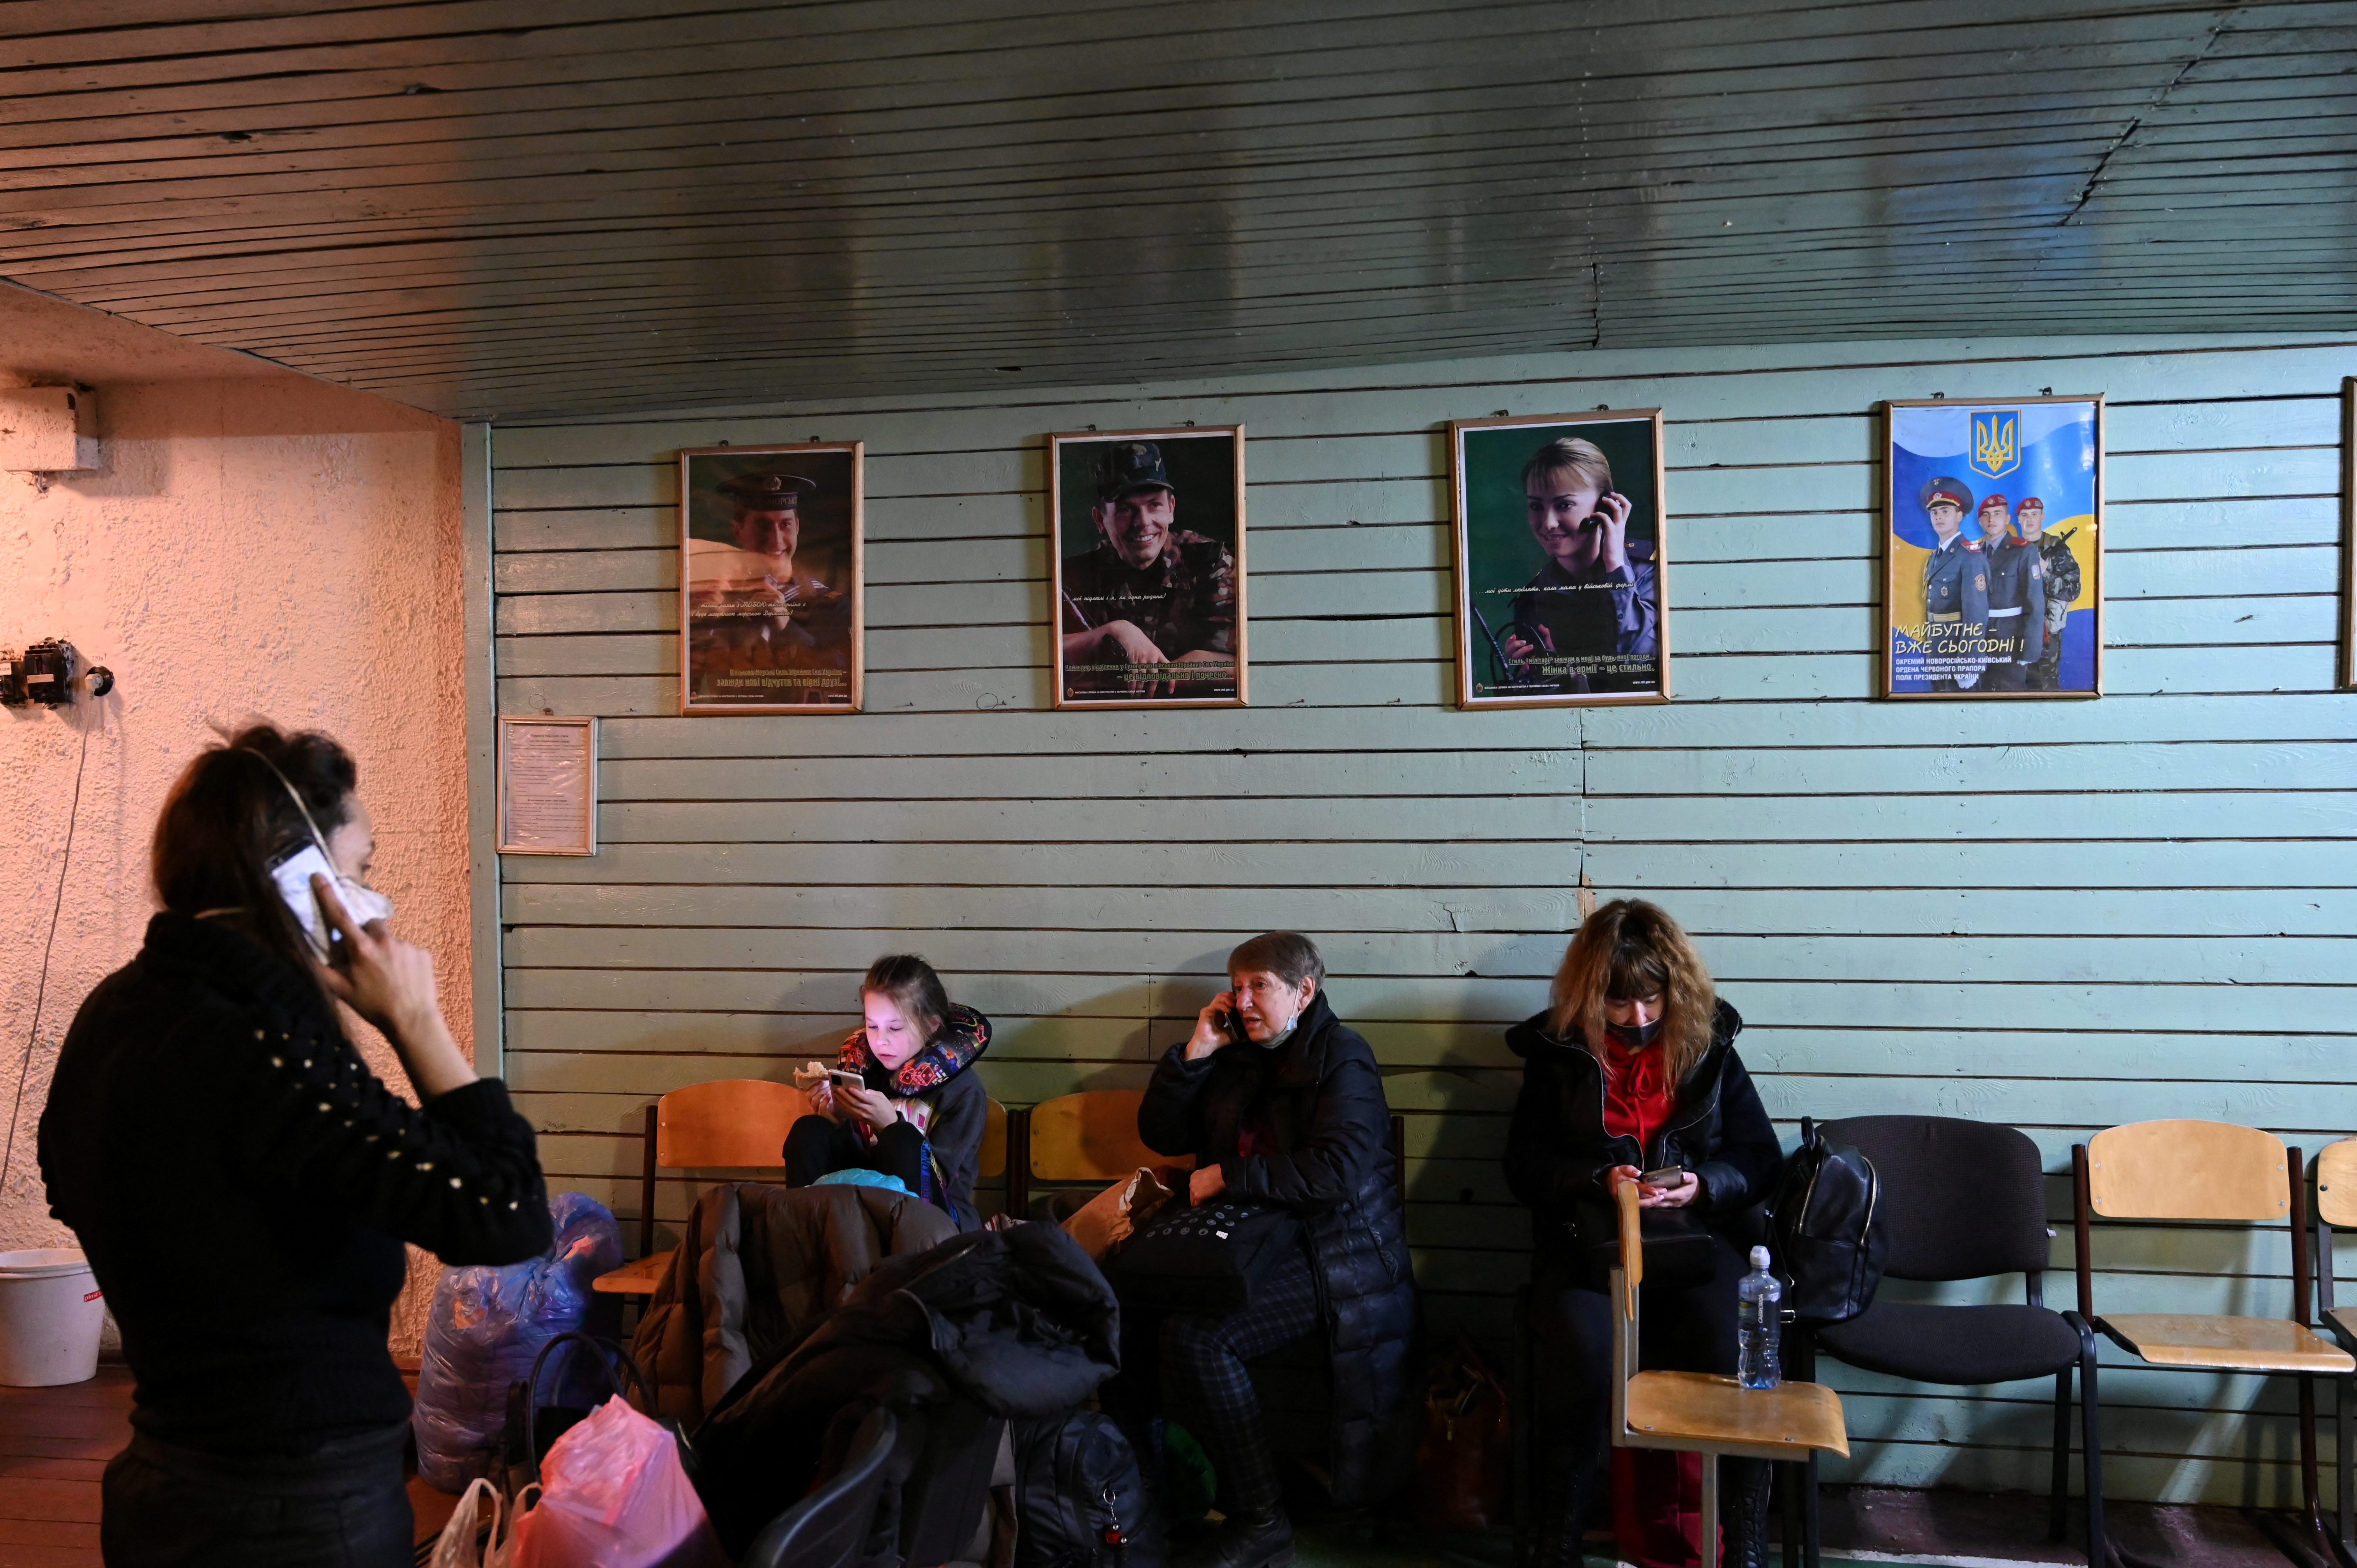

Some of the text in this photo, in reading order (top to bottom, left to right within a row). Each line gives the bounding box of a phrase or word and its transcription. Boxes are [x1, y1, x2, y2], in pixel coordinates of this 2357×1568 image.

[1142, 592, 1166, 601] родина!
[1895, 622, 1983, 638] МАЙБУТНЄ
[1895, 640, 1933, 654] ВЖЕ
[1938, 636, 2014, 653] СЬОГОДНІ
[1602, 654, 1629, 662] будь-якої
[1926, 655, 2012, 664] НОВОРОСІЙСЬКО-КИЇВСЬКИЙ
[1177, 662, 1202, 670] Збройних
[1213, 660, 1235, 669] України
[1542, 666, 1567, 675] Жінка
[1576, 664, 1597, 675] армії
[1606, 665, 1618, 674] це
[1619, 664, 1655, 673] стильно.
[1124, 673, 1134, 683] це
[1135, 671, 1190, 682] відповідально
[1191, 670, 1195, 680] і
[717, 679, 744, 687] завжди
[745, 677, 760, 686] нові
[761, 678, 792, 687] відчуття
[802, 677, 820, 687] вірні
